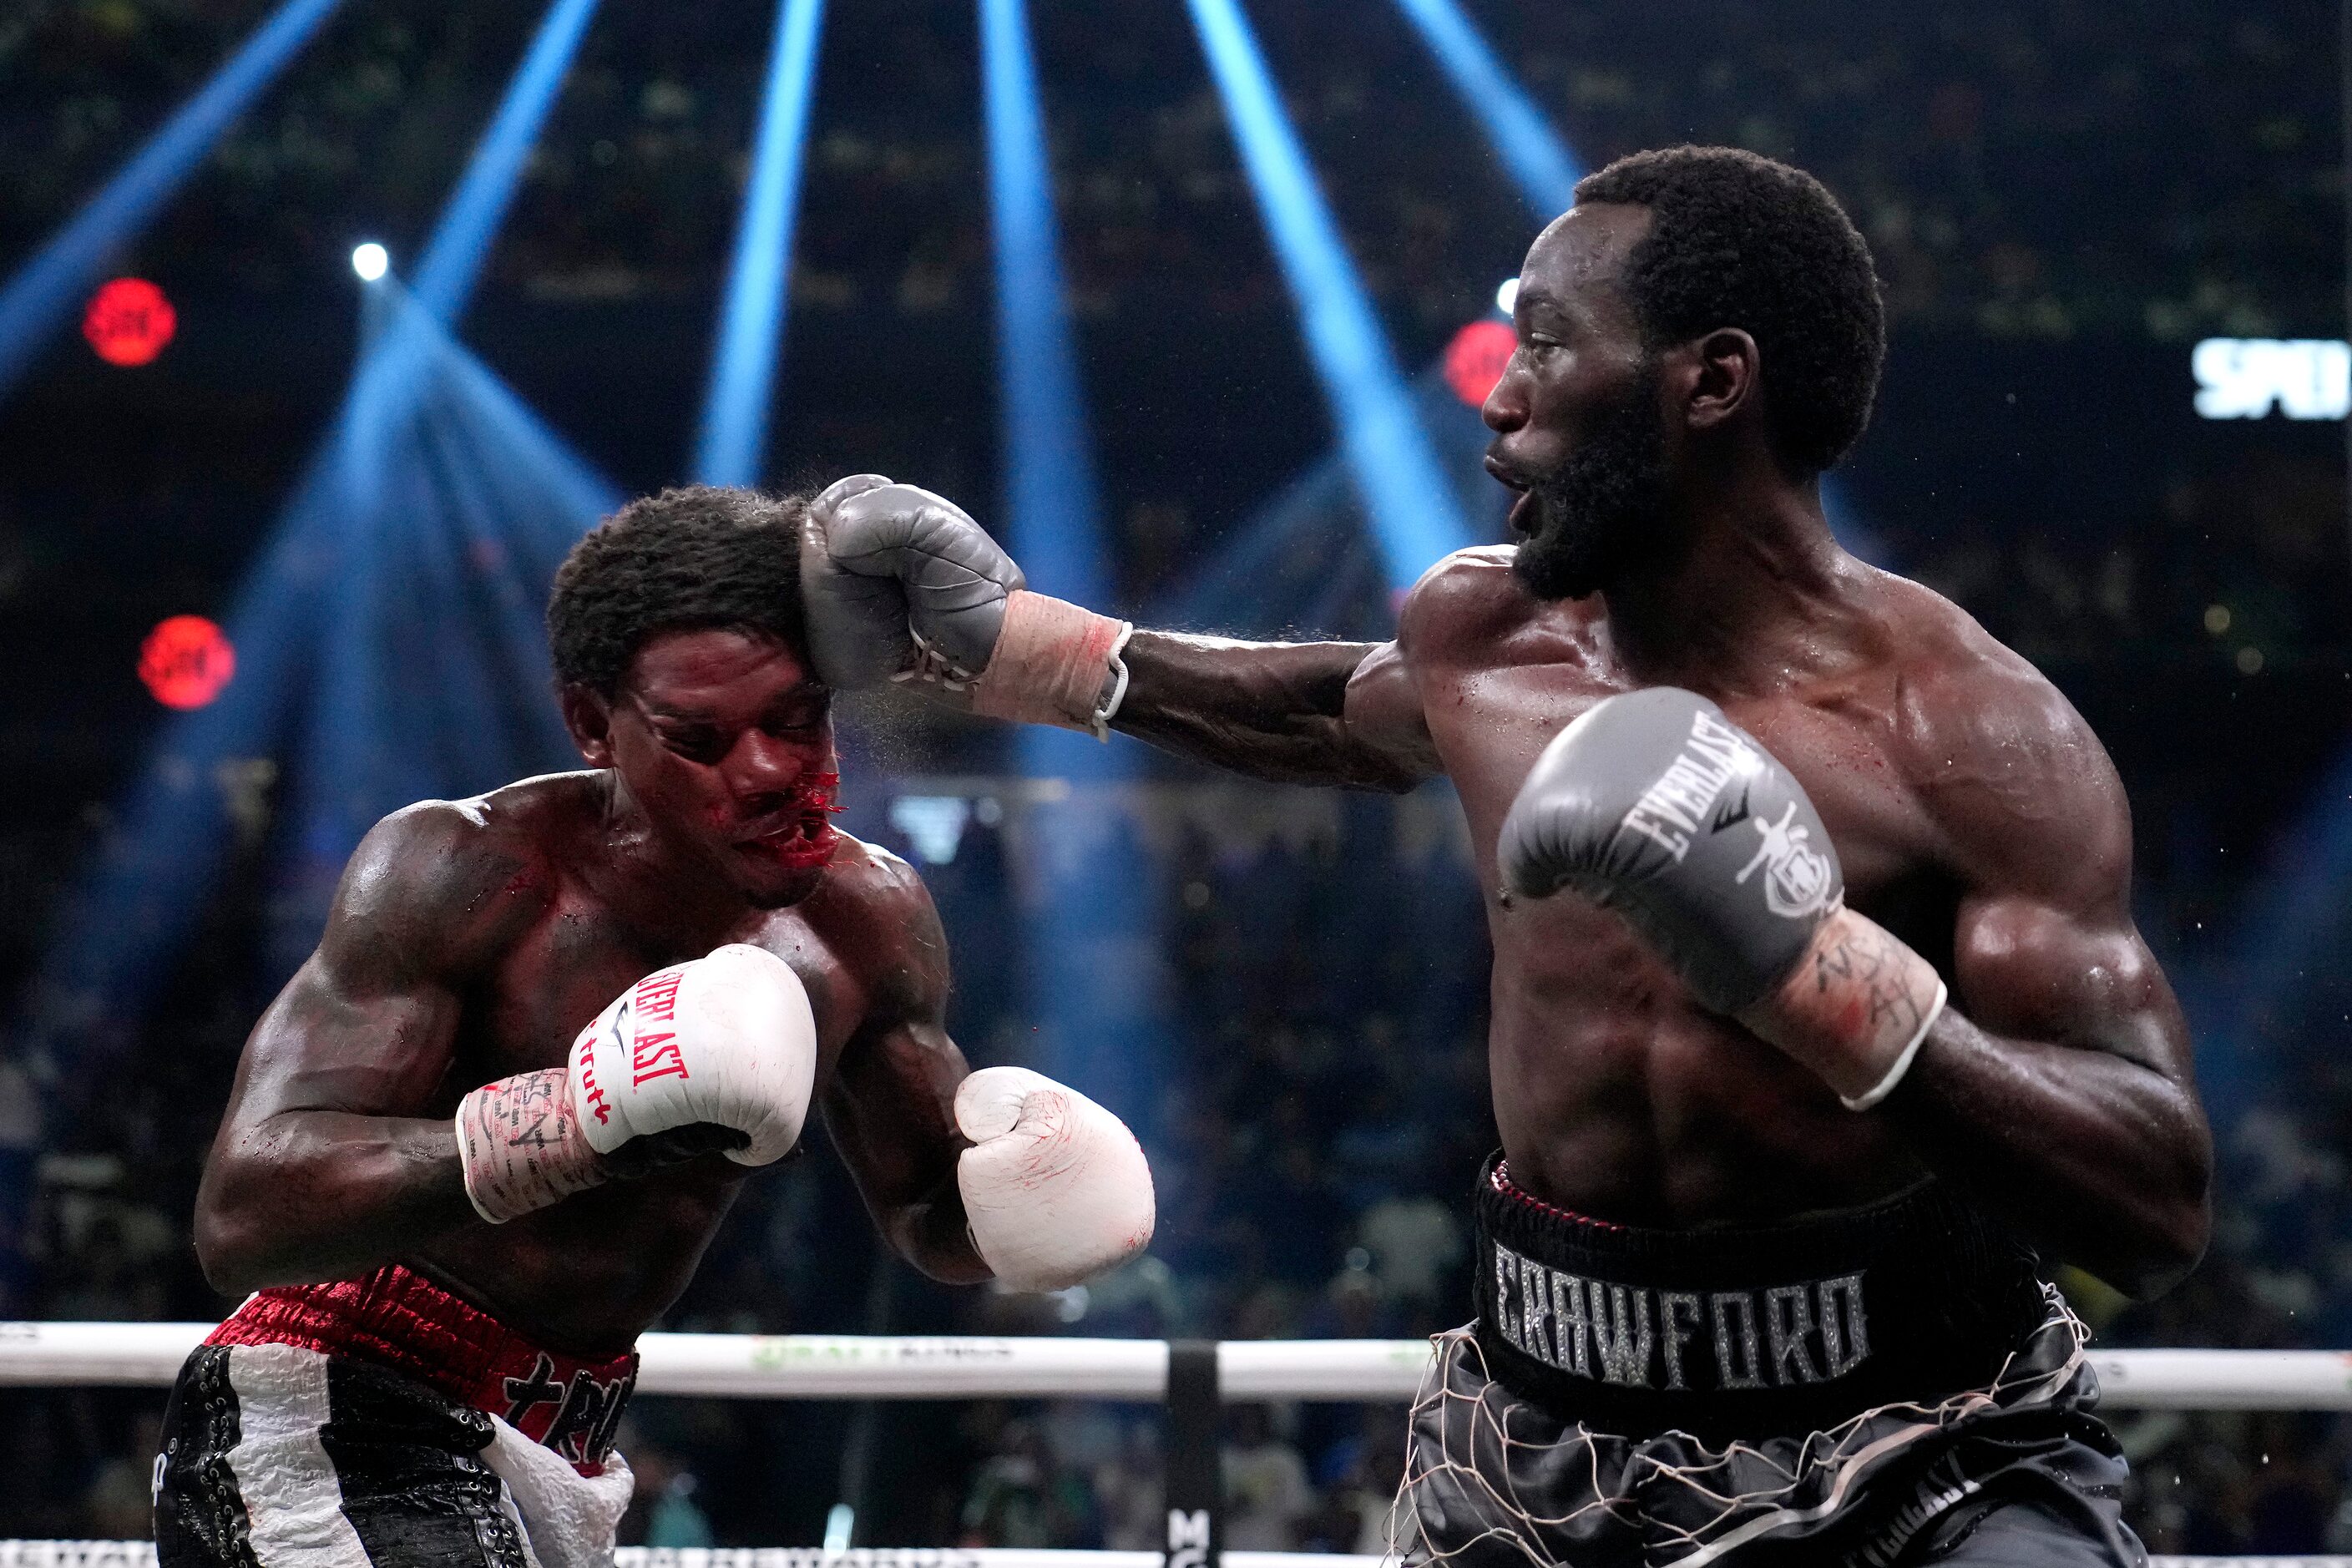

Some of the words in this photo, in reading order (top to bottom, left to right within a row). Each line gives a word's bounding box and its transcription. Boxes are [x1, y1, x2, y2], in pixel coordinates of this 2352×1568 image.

[1622, 710, 1760, 862] EVERLAST
[634, 972, 690, 1088] EVERLAST
[1493, 1239, 1873, 1391] CRAWFORD
